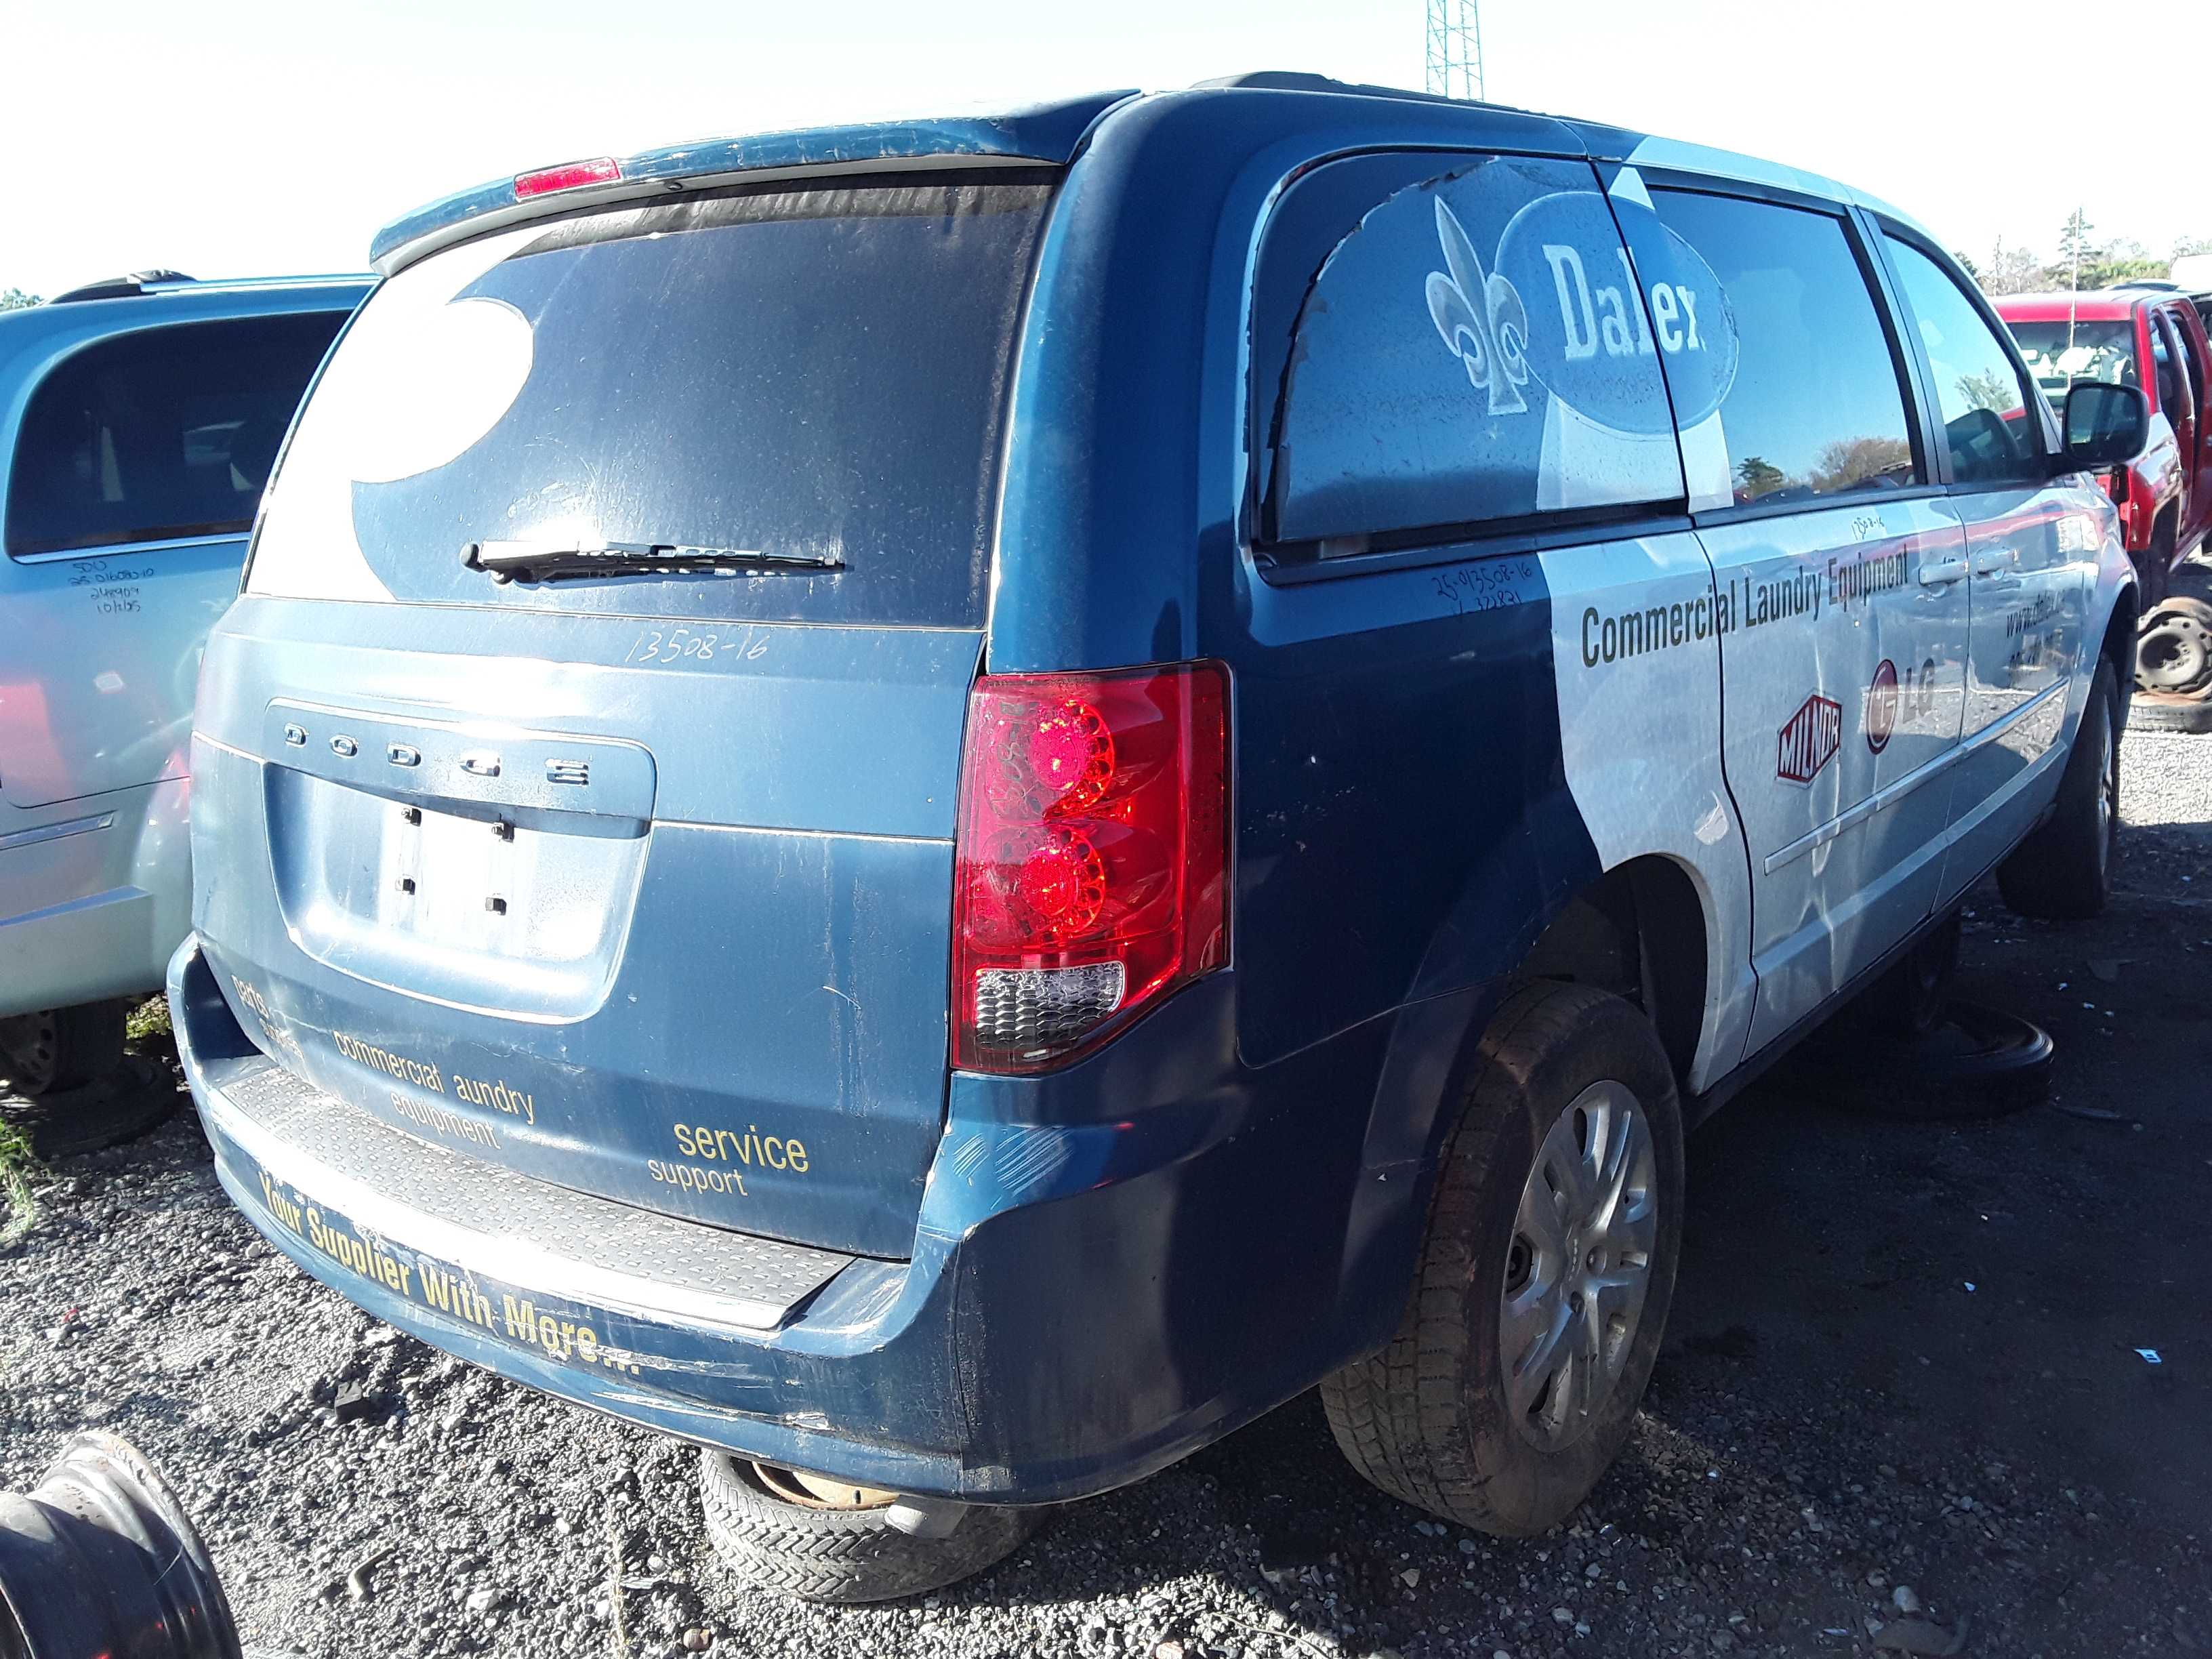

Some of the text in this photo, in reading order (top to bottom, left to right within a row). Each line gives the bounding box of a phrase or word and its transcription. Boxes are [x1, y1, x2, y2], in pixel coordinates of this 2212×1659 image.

[1542, 244, 1706, 361] Dalex
[1582, 544, 1908, 668] Commercial Laundry Equipment
[624, 626, 771, 663] 13508-16
[1903, 658, 1935, 724] LG
[283, 722, 590, 787] DODGE
[230, 974, 270, 1019] parts
[390, 1091, 501, 1150] equipment
[673, 1123, 808, 1173] service
[647, 1159, 748, 1197] support
[306, 1206, 409, 1296] Supplier
[417, 1261, 493, 1329] With
